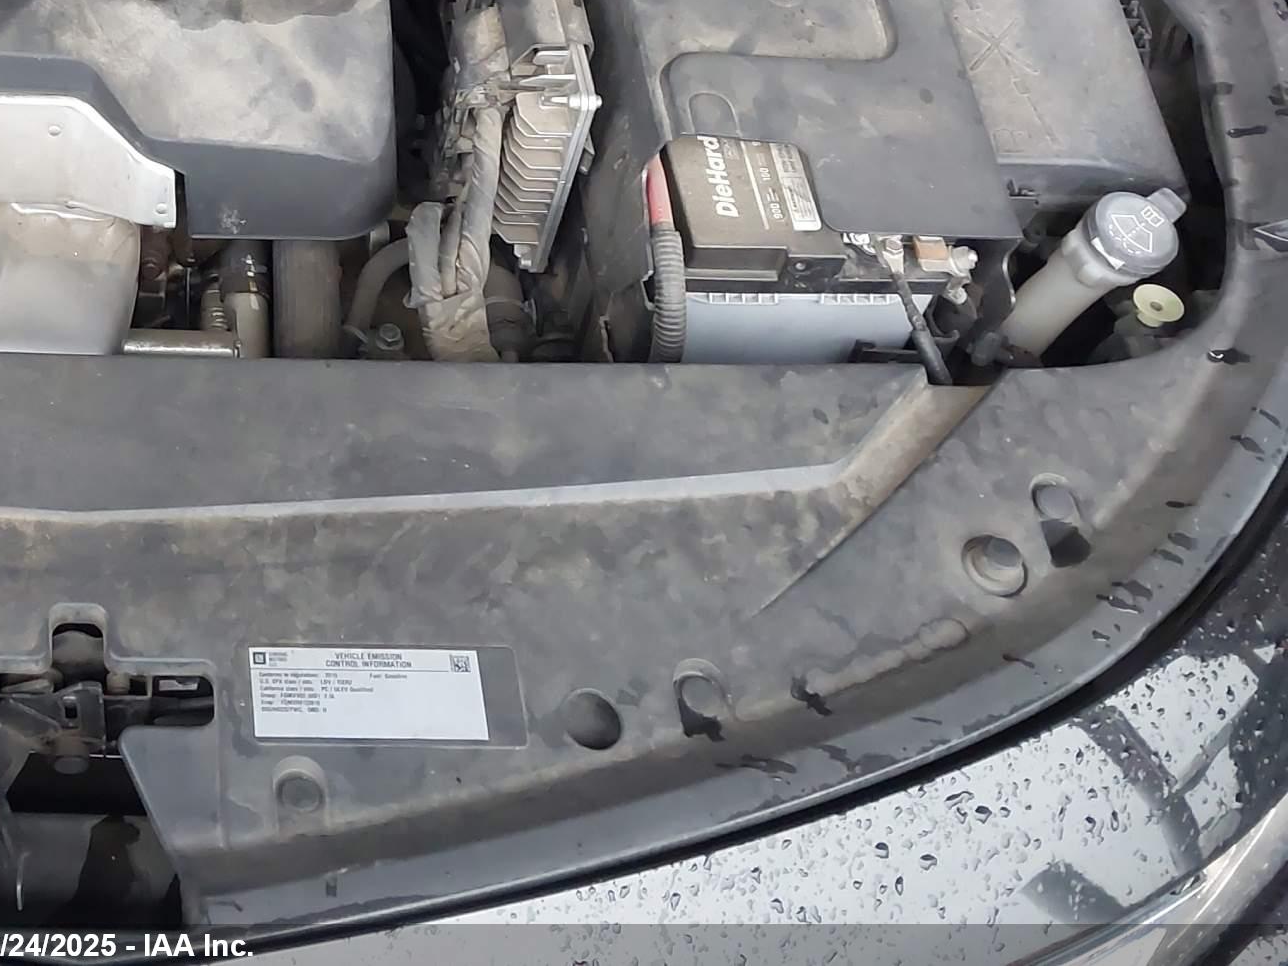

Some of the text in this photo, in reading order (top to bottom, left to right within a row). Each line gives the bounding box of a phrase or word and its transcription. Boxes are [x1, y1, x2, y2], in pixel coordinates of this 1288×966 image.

[696, 135, 740, 218] DieHard
[334, 652, 403, 661] VEHICLE EMISSION
[325, 660, 413, 669] CONTROL INFORMATION
